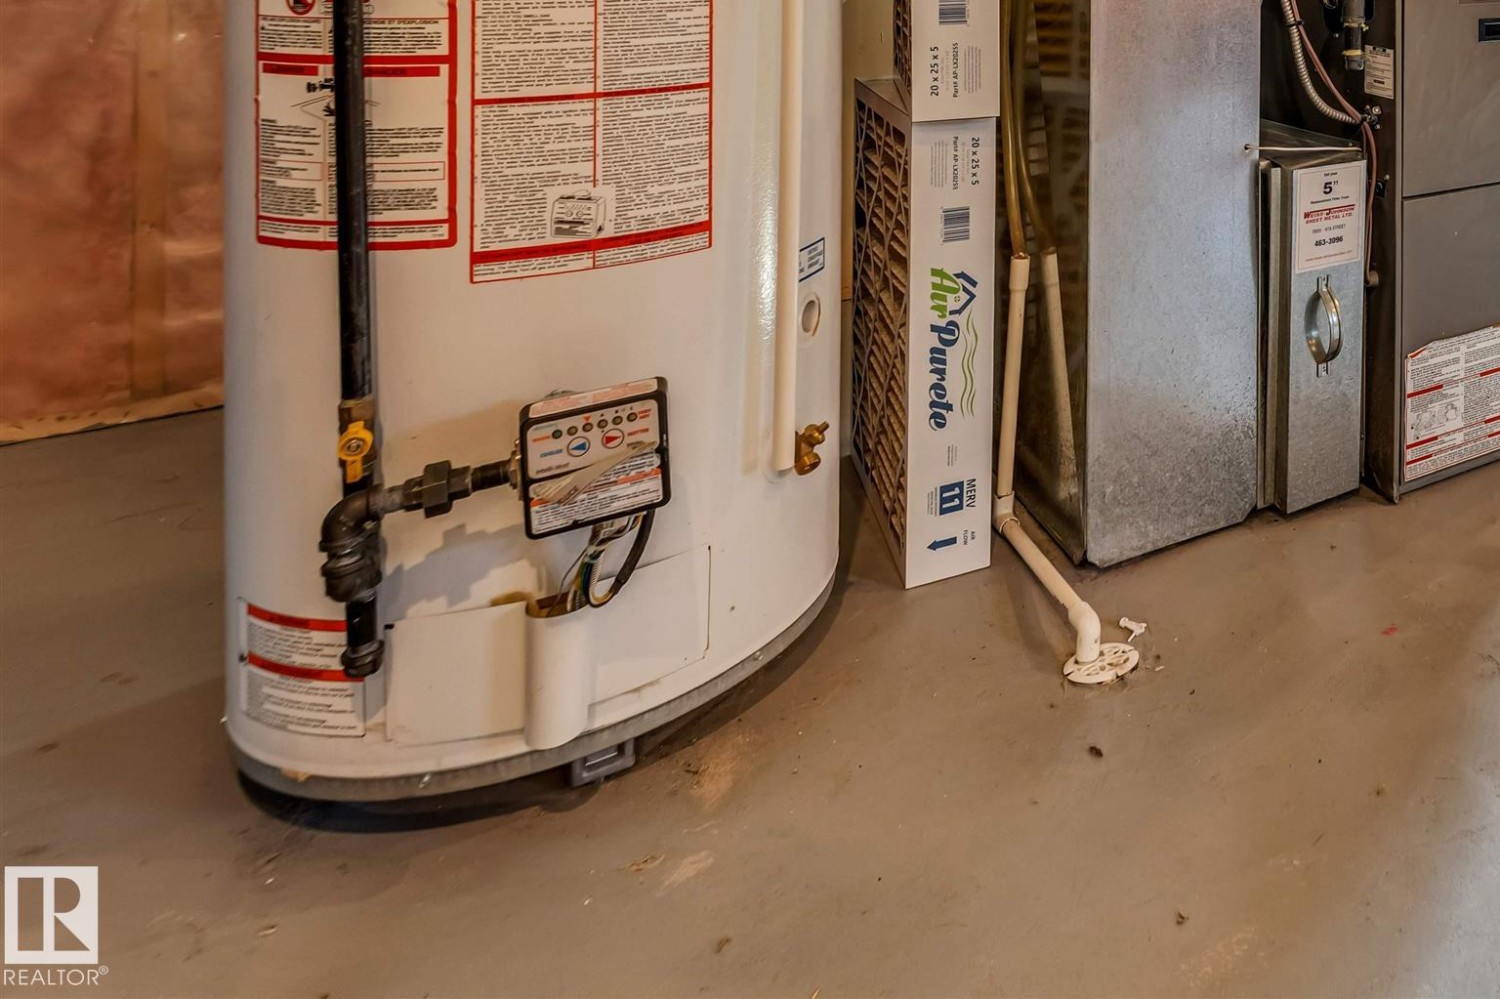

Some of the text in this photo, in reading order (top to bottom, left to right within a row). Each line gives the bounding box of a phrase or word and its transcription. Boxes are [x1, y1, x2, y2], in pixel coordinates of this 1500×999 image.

[930, 63, 939, 74] 25
[930, 85, 939, 97] 20
[970, 136, 979, 148] 20
[970, 158, 979, 170] 25
[1314, 235, 1343, 247] 463-3096
[929, 267, 964, 319] Air
[927, 319, 961, 432] Purete
[941, 486, 961, 510] 11
[965, 478, 976, 508] MERV
